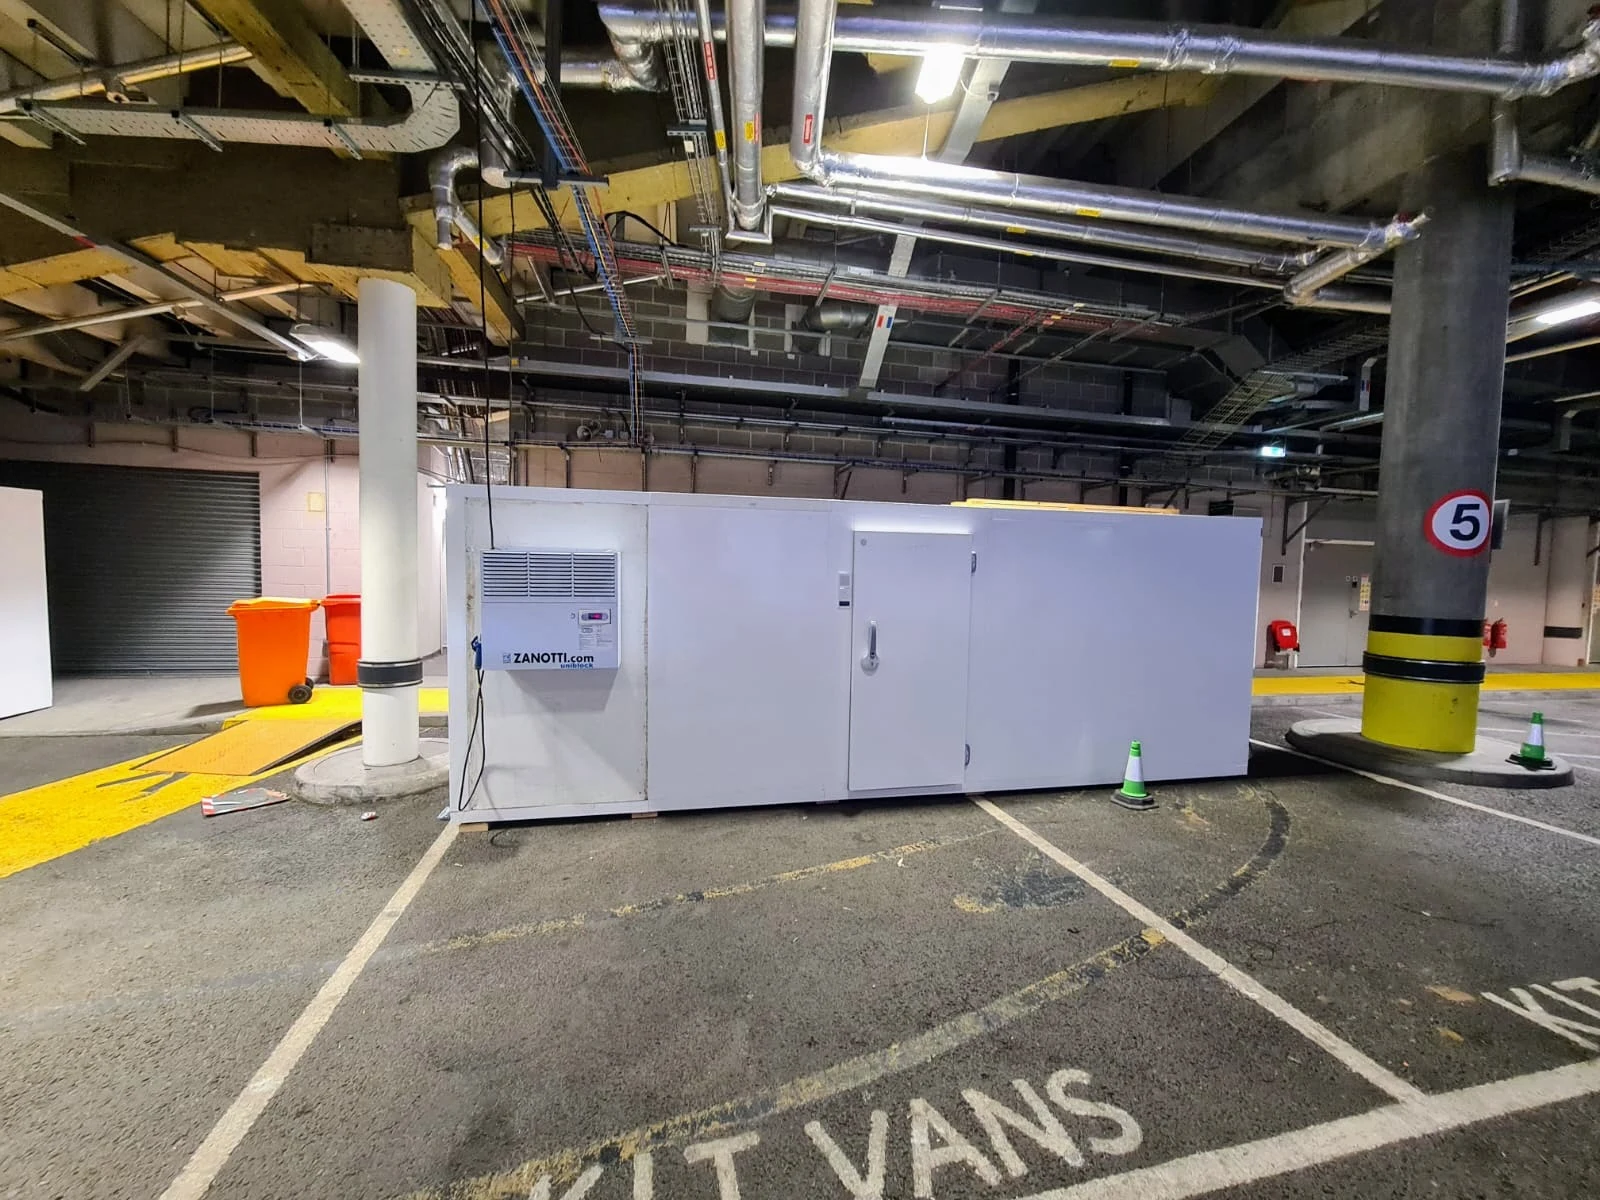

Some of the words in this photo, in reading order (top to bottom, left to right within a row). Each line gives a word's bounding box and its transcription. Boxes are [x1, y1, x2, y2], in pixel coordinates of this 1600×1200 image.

[1449, 503, 1480, 541] 5
[513, 652, 594, 664] ZANOTTI.com
[527, 1131, 761, 1200] IT
[804, 1068, 1143, 1200] VANS
